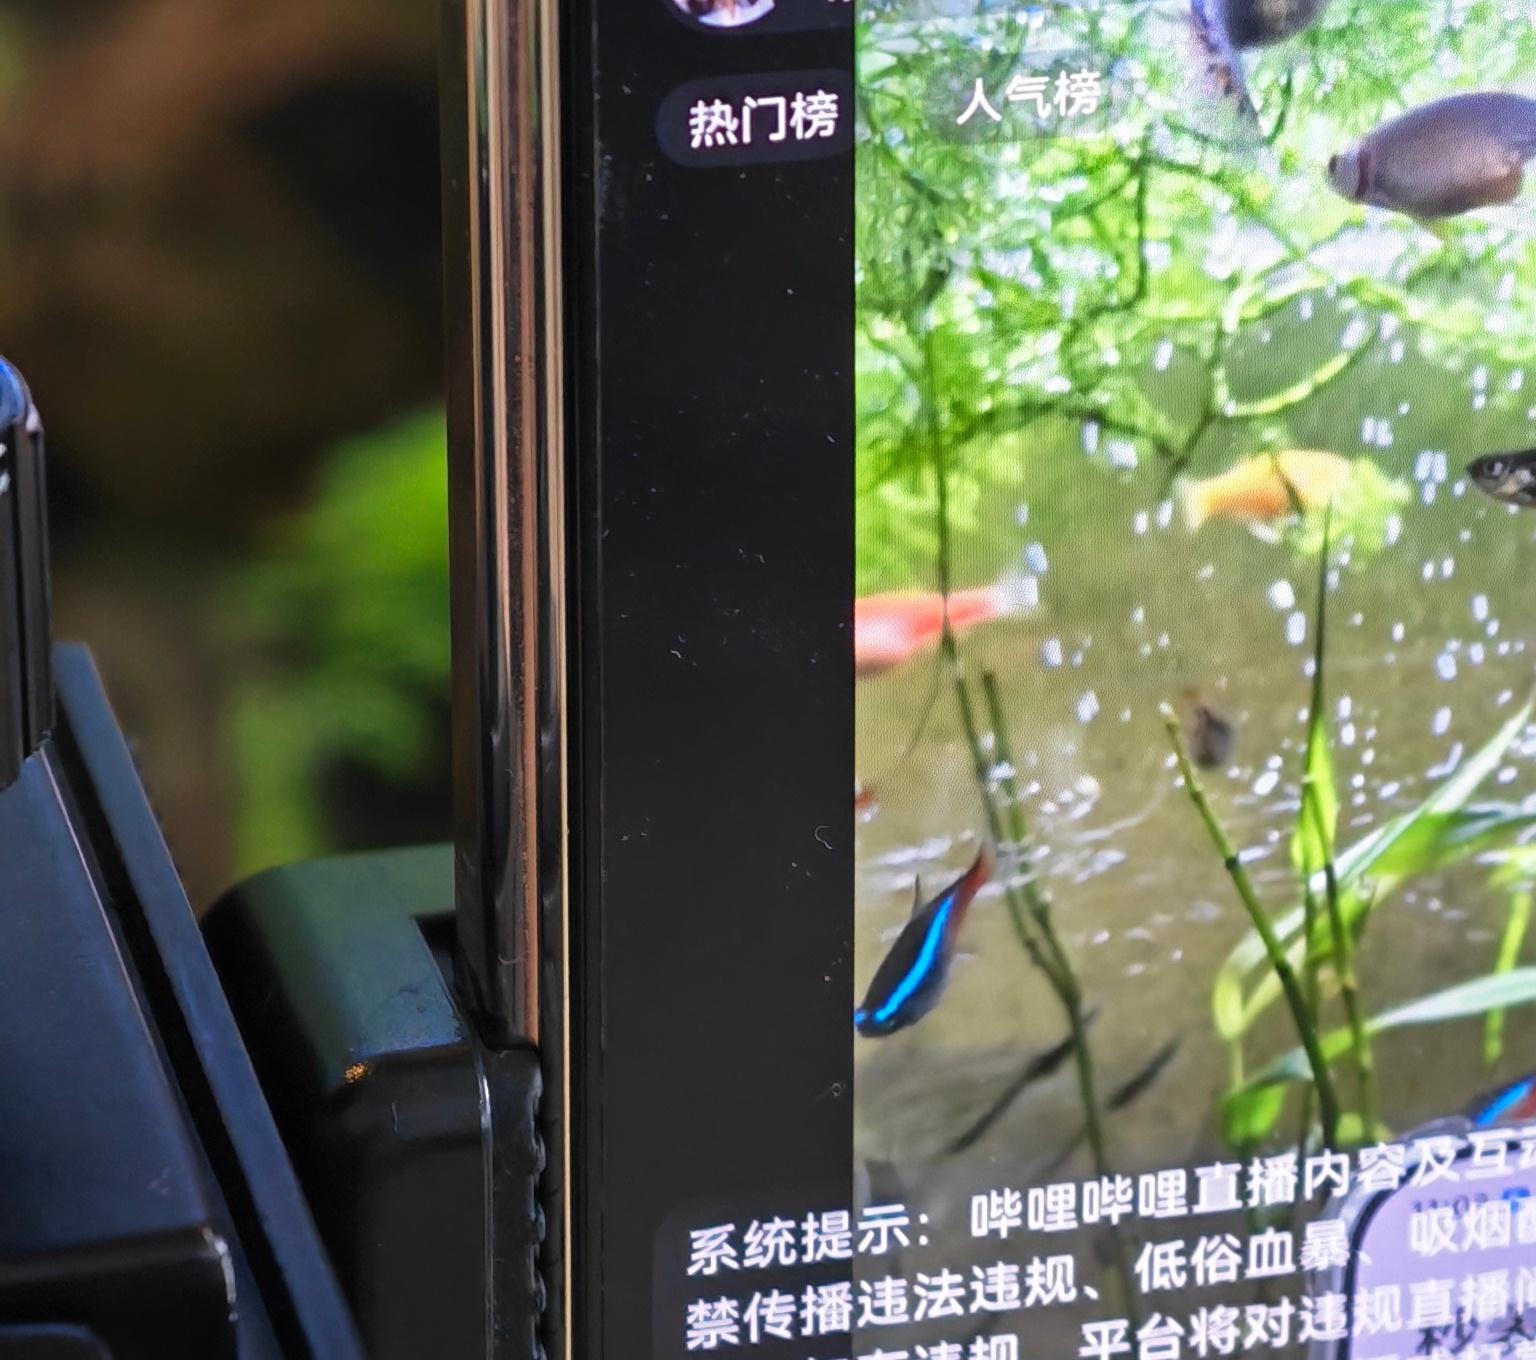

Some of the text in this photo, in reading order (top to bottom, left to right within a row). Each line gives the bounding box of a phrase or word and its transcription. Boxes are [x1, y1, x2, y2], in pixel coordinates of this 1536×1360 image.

[689, 90, 839, 148] 热门榜
[956, 69, 1102, 126] 人气榜
